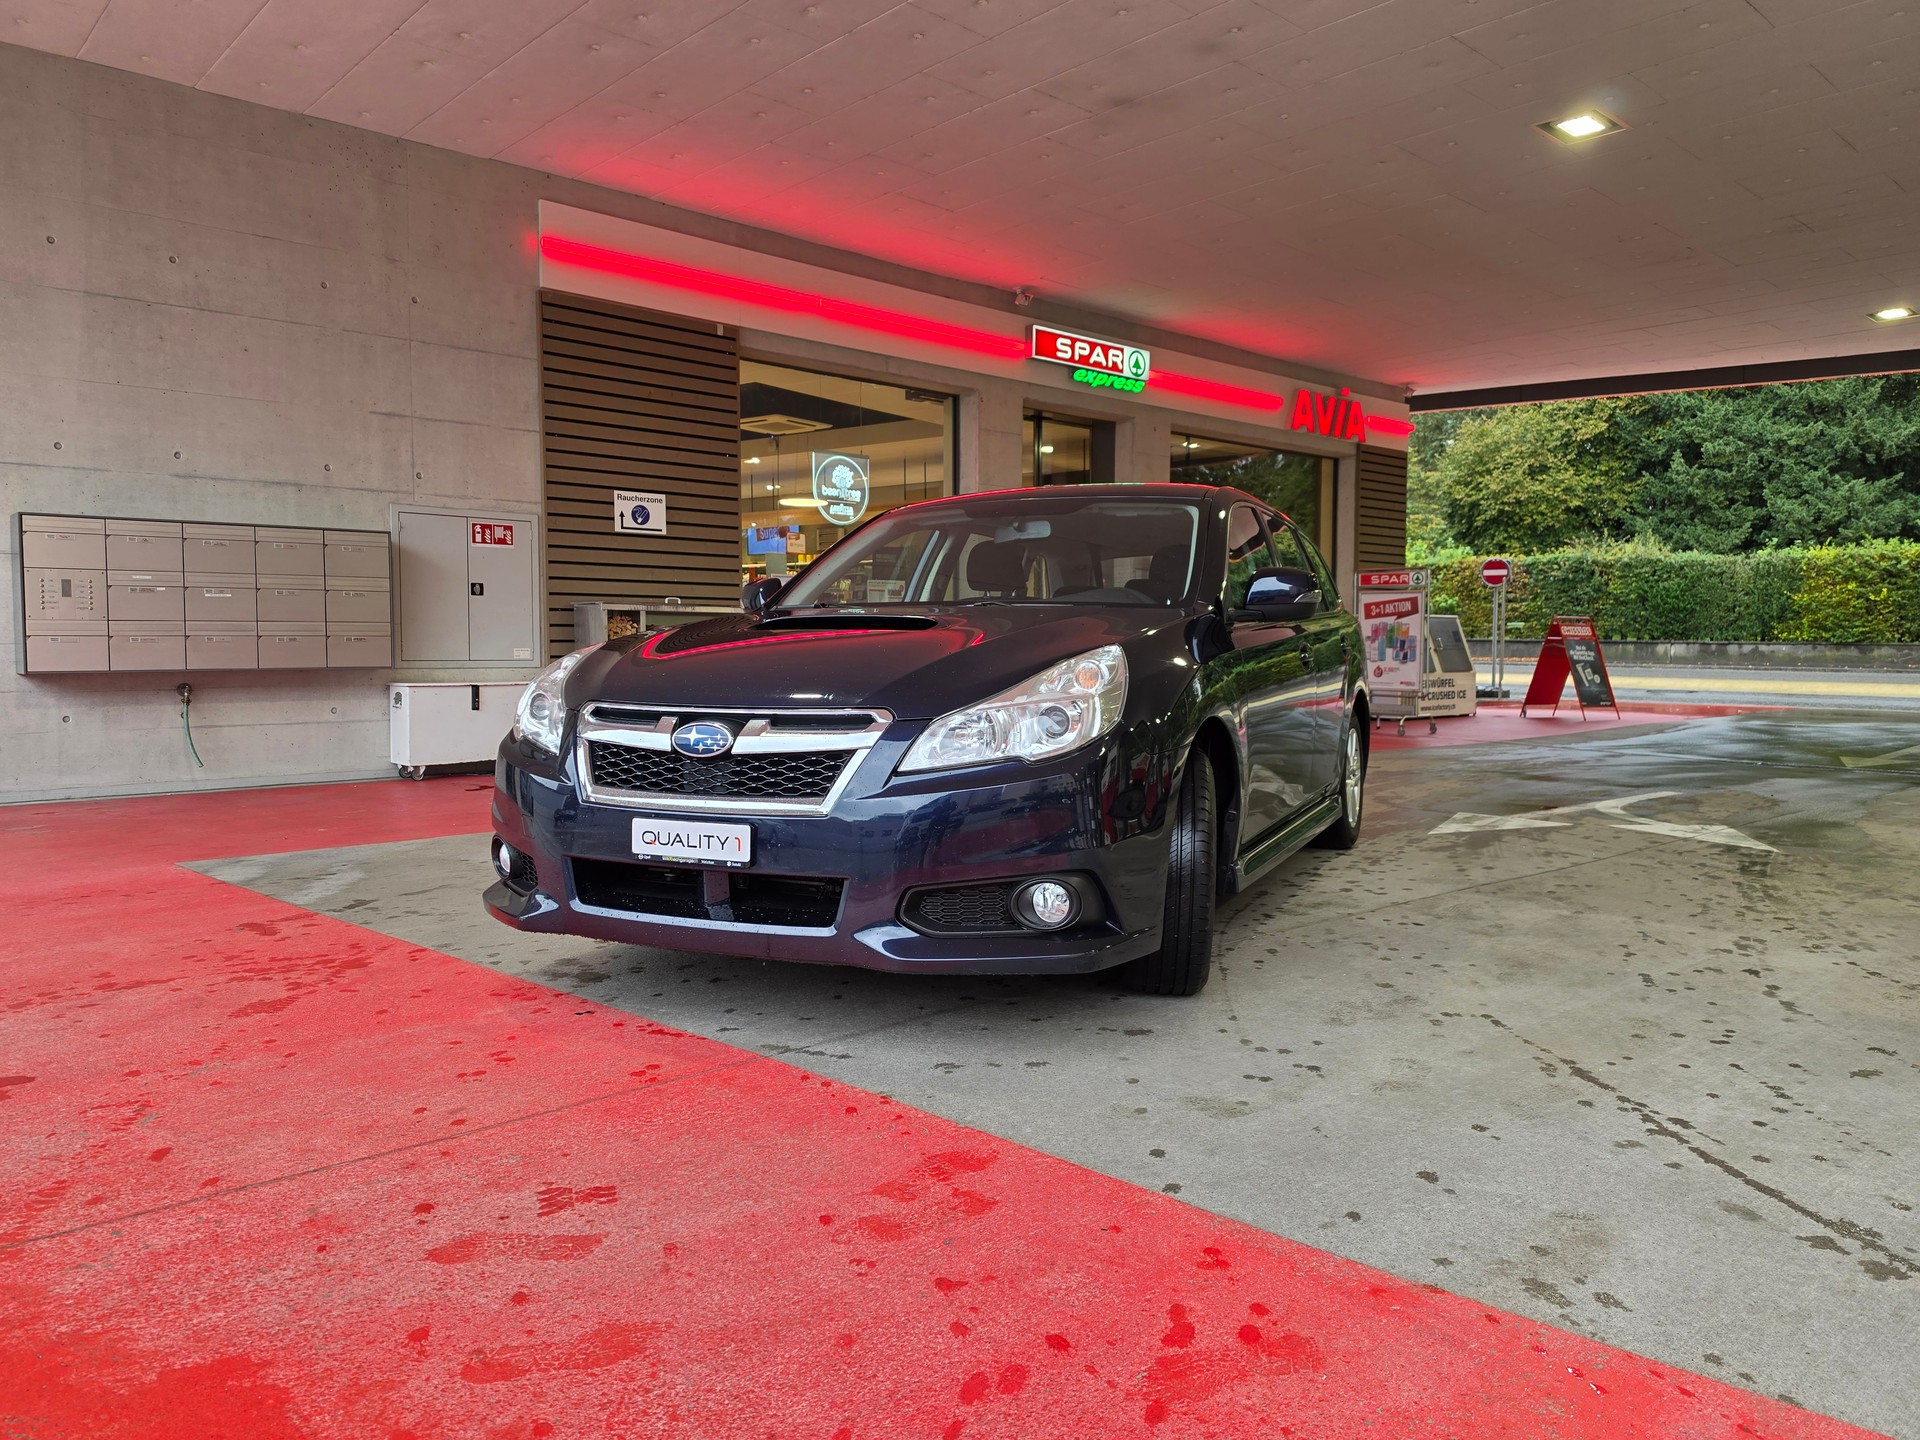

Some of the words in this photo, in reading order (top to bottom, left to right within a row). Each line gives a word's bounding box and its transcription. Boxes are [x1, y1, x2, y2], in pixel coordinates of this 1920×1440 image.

[1055, 337, 1123, 370] SPAR
[1073, 368, 1145, 393] express
[617, 493, 663, 504] Raucherzone
[1370, 575, 1409, 585] SPAR
[1370, 604, 1384, 616] 3+1
[1384, 600, 1412, 614] AKTION
[1427, 690, 1456, 701] CRUSHED
[1457, 689, 1467, 699] ICE
[641, 830, 730, 851] QUALITY
[734, 836, 741, 852] 1
